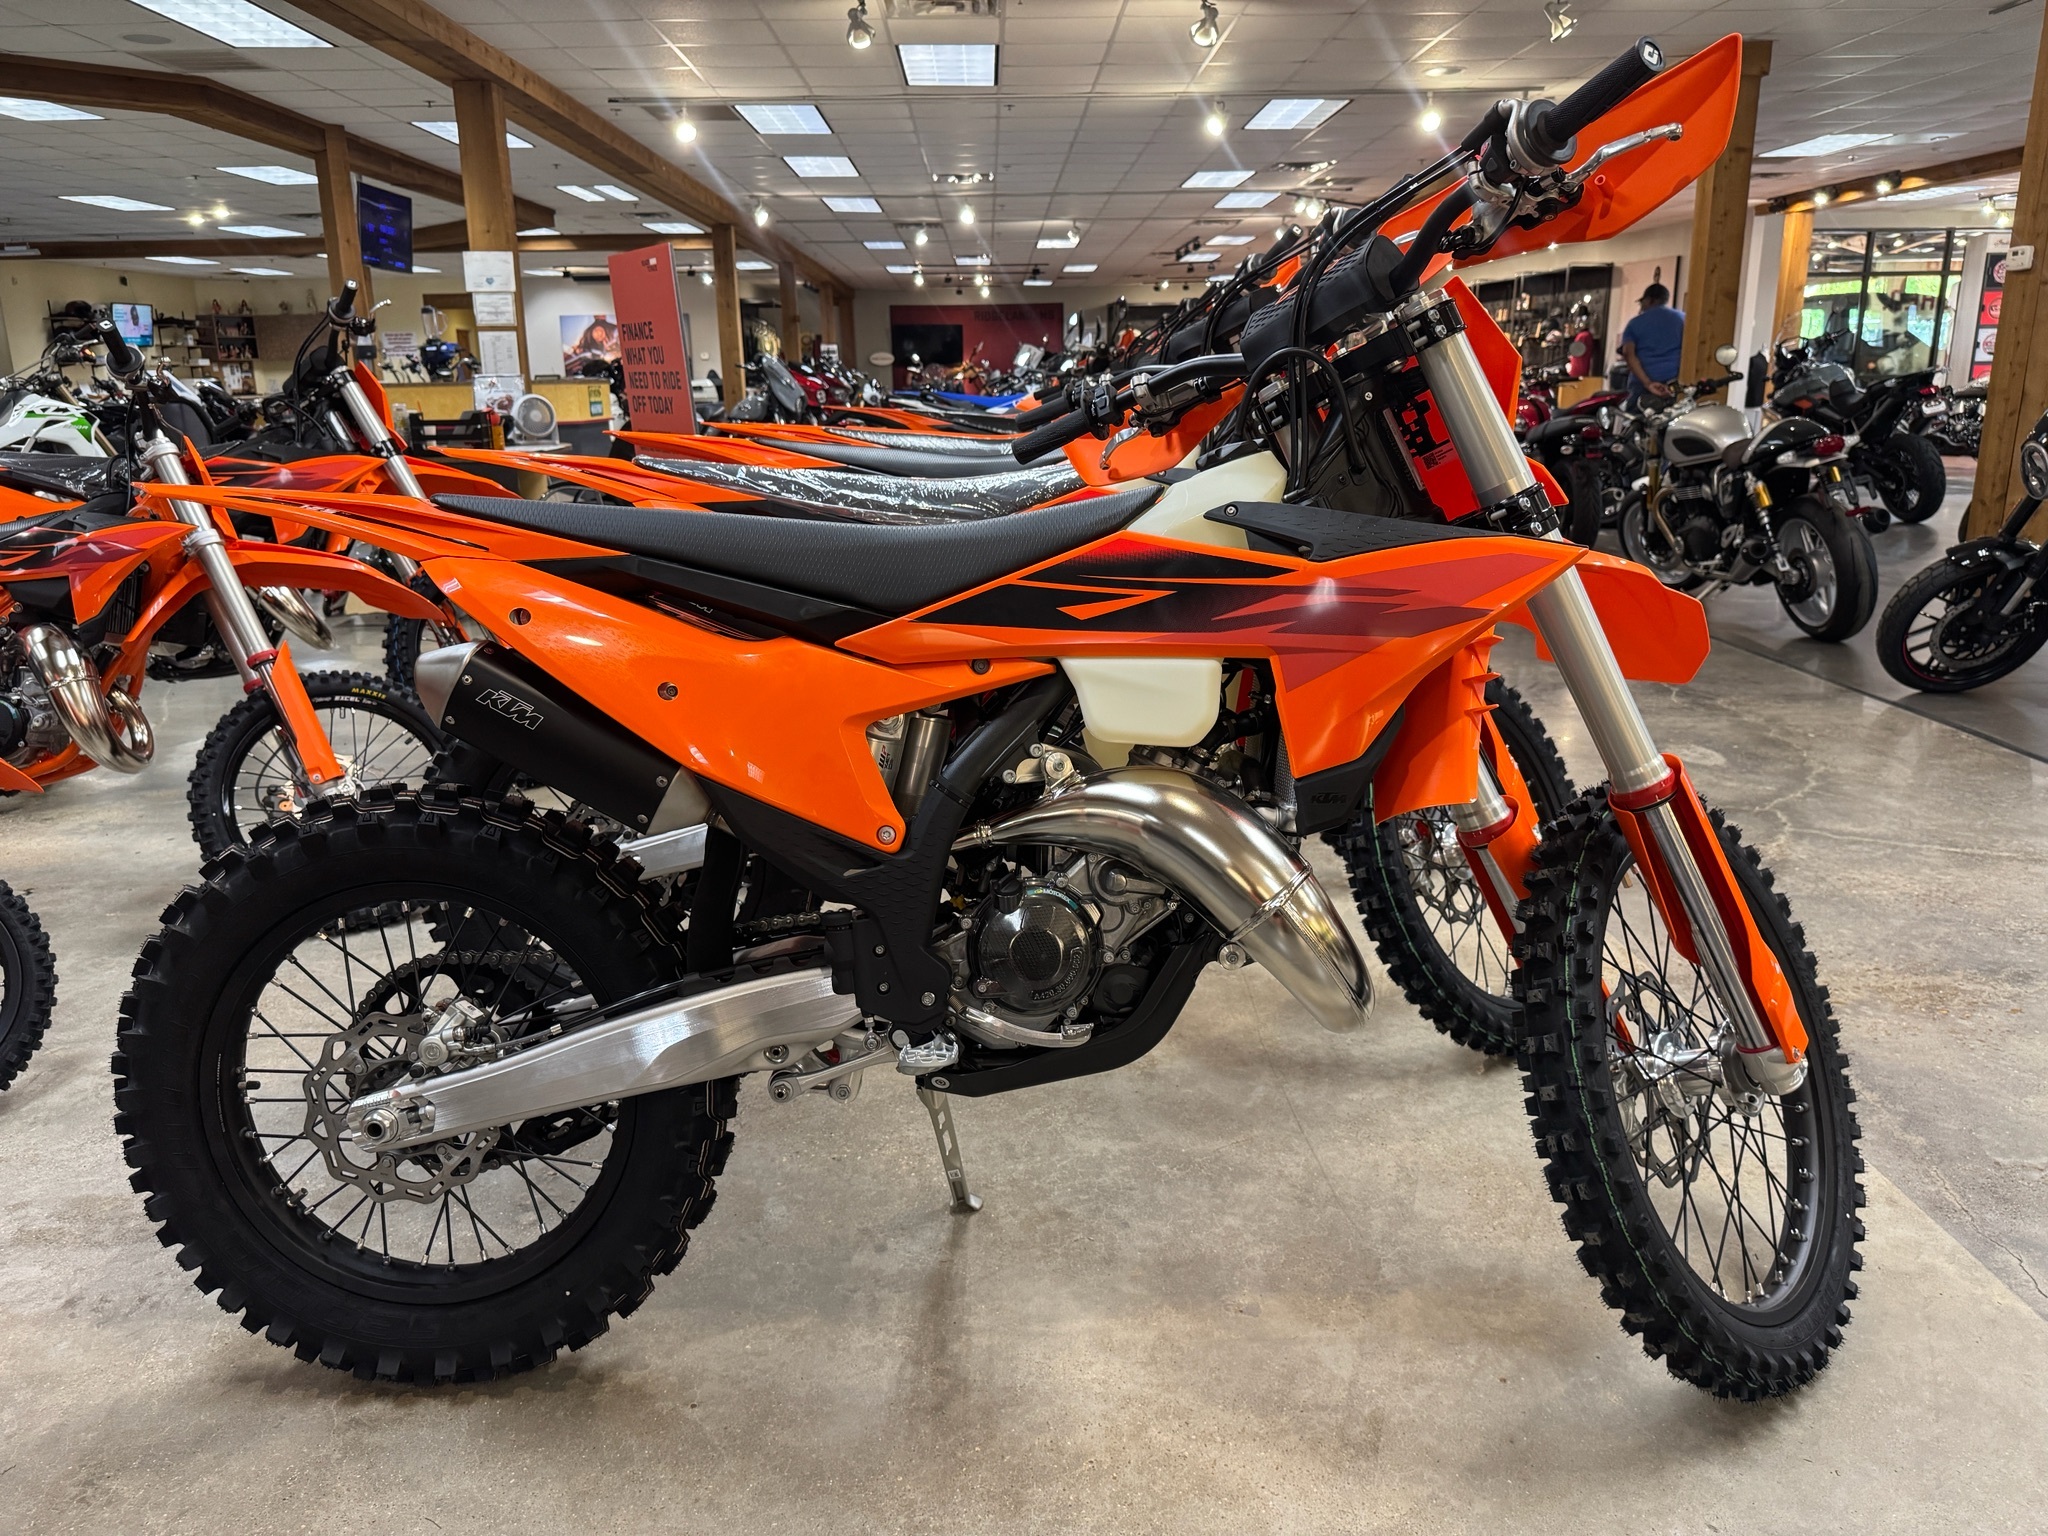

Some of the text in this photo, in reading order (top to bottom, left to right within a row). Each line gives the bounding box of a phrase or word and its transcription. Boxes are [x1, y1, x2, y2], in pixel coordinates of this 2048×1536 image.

[621, 321, 654, 341] FINANCE
[625, 346, 665, 366] WHAT YOU
[628, 371, 682, 390] NEED TO RIDE
[632, 395, 674, 415] OFF TODAY
[351, 687, 387, 699] MAXXIS
[475, 688, 544, 731] KTM
[1311, 792, 1347, 804] KTM
[1043, 888, 1071, 904] MOTOREX
